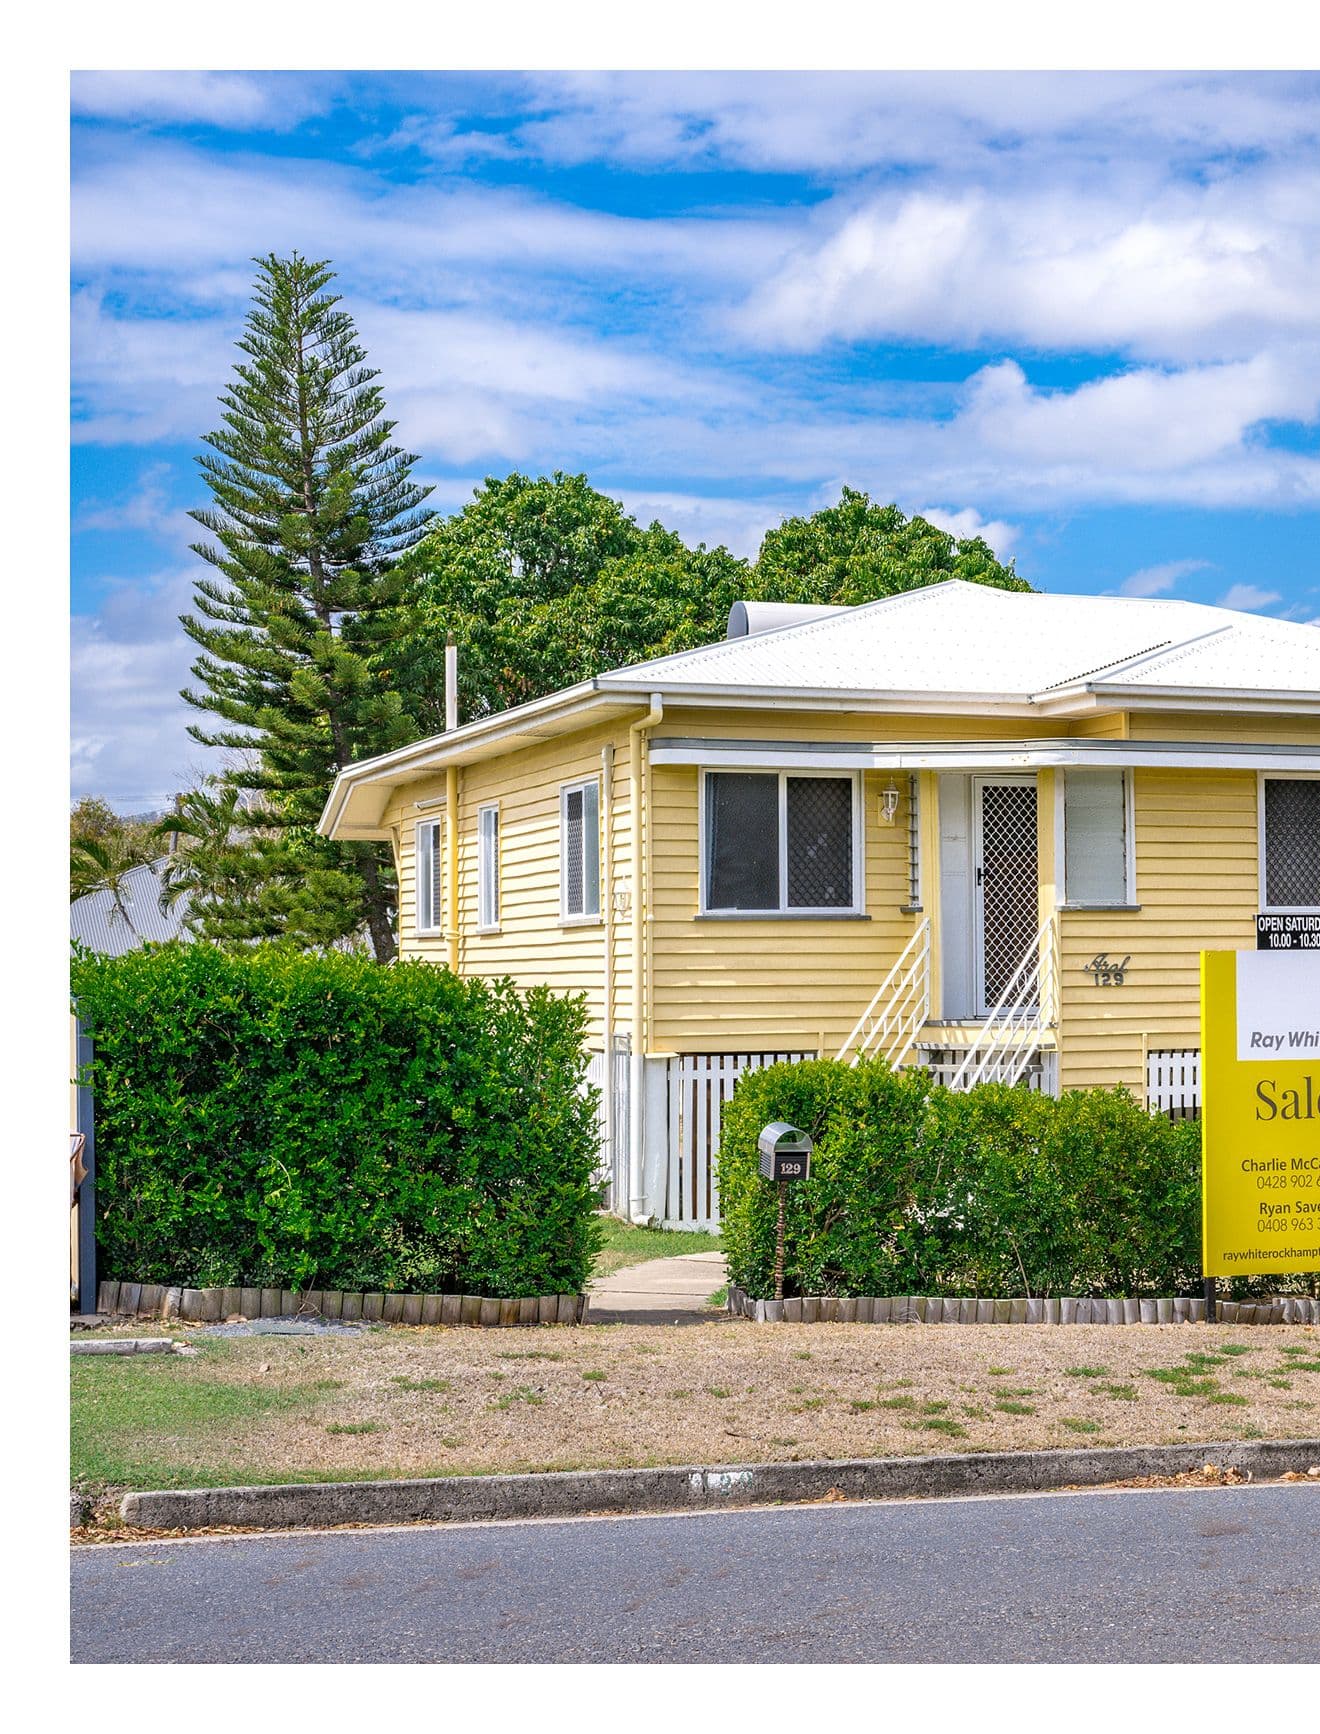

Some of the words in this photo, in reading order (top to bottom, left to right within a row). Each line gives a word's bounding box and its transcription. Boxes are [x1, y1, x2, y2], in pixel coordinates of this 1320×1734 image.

[1258, 917, 1284, 932] OPEN
[1269, 933, 1291, 948] 10.00
[1299, 933, 1320, 948] 10.30
[1095, 973, 1124, 987] 129
[1250, 1031, 1285, 1051] Ray
[780, 1162, 801, 1175] 129
[1241, 1158, 1287, 1172] Charlie
[1256, 1175, 1287, 1190] 0428
[1290, 1174, 1313, 1189] 902
[1259, 1202, 1291, 1218] Ryan
[1257, 1218, 1288, 1233] 0408
[1291, 1217, 1314, 1232] 963
